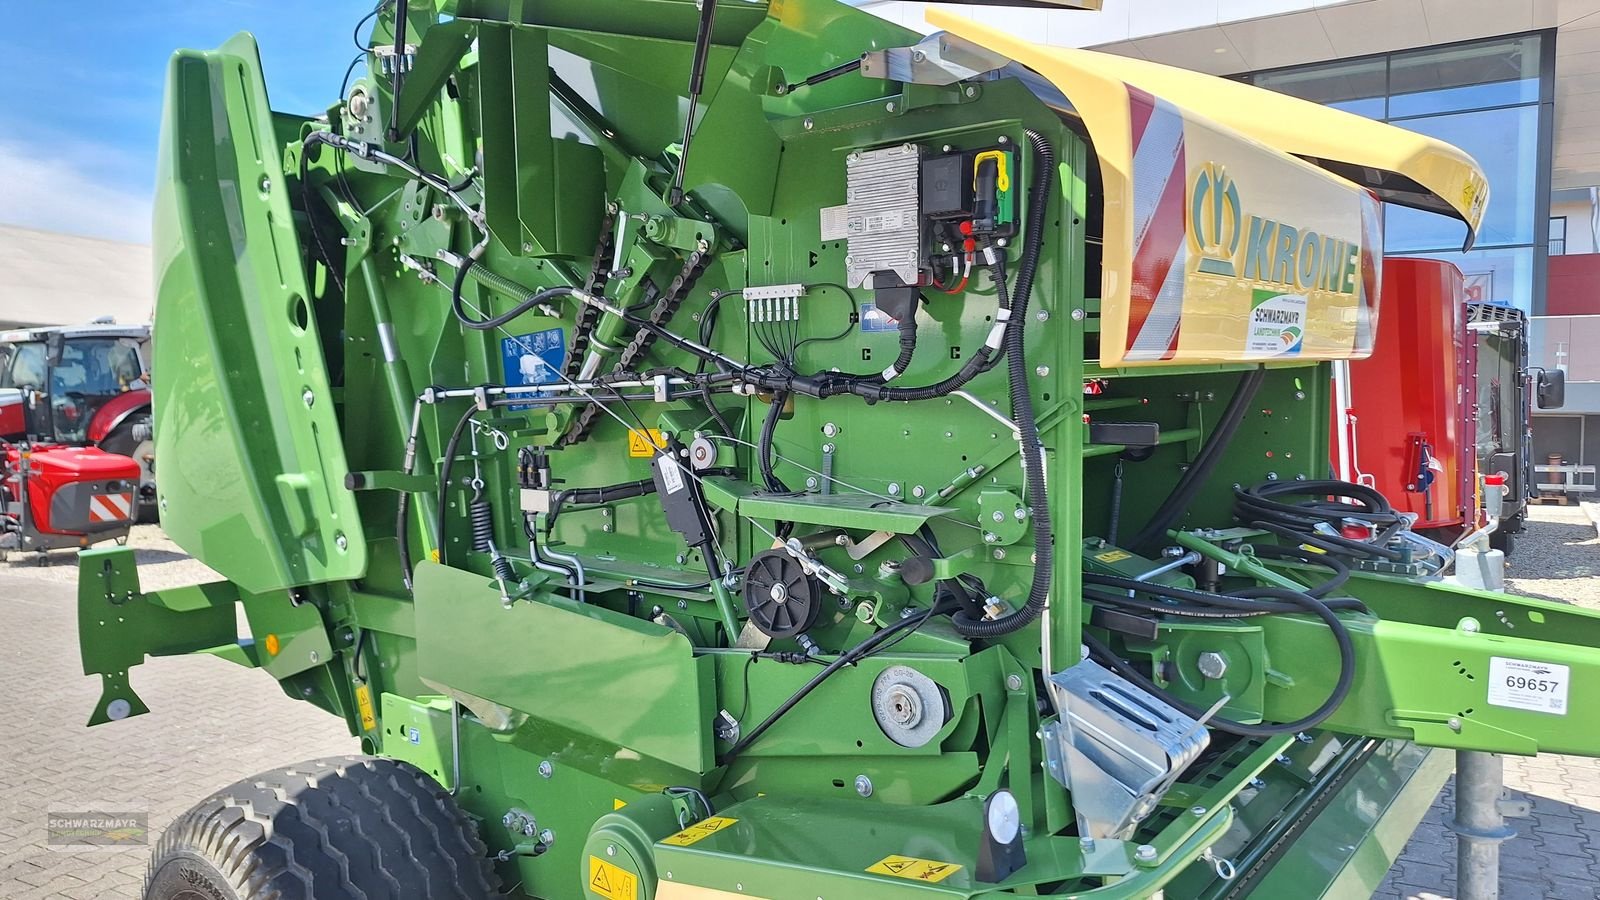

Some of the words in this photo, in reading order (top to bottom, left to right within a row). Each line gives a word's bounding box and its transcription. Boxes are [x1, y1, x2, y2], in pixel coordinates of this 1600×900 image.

[1244, 215, 1359, 294] KRONE
[1255, 308, 1299, 324] SCHWARZMAYR
[1506, 675, 1559, 693] 69657
